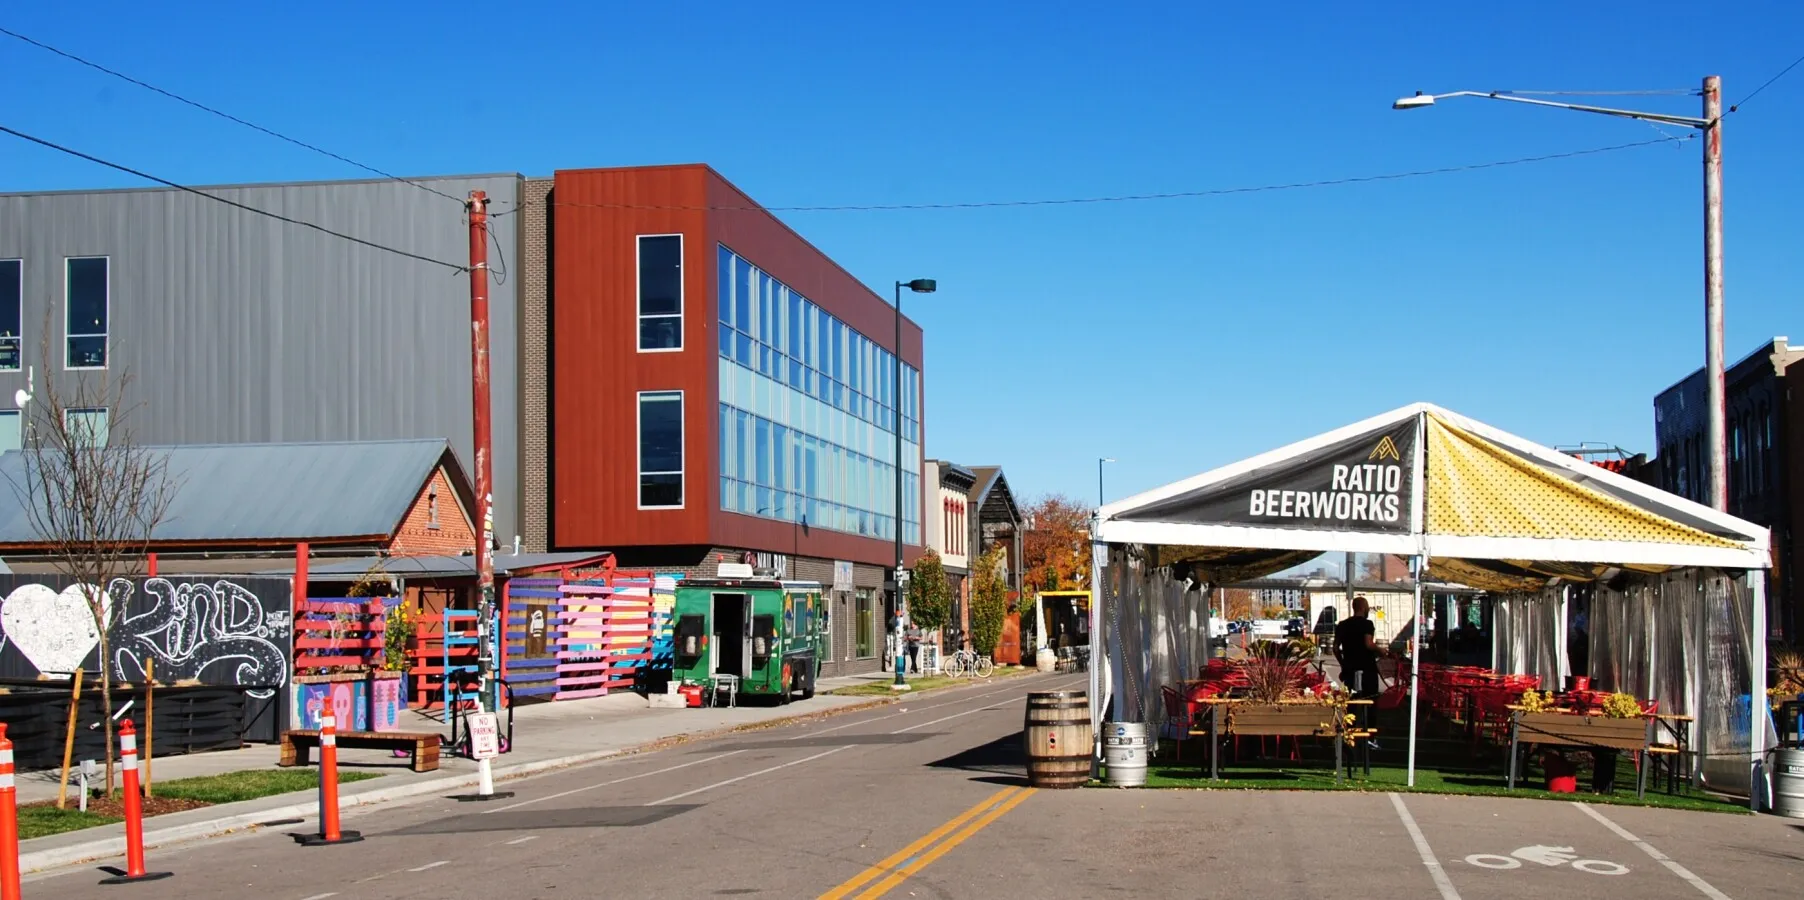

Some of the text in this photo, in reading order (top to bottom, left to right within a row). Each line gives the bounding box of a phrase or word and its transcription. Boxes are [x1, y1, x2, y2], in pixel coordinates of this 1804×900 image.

[1332, 464, 1400, 492] RATIO
[1250, 489, 1399, 522] BEERWORKS
[773, 553, 787, 578] BAR
[473, 727, 495, 735] PARKING
[479, 717, 488, 726] NO
